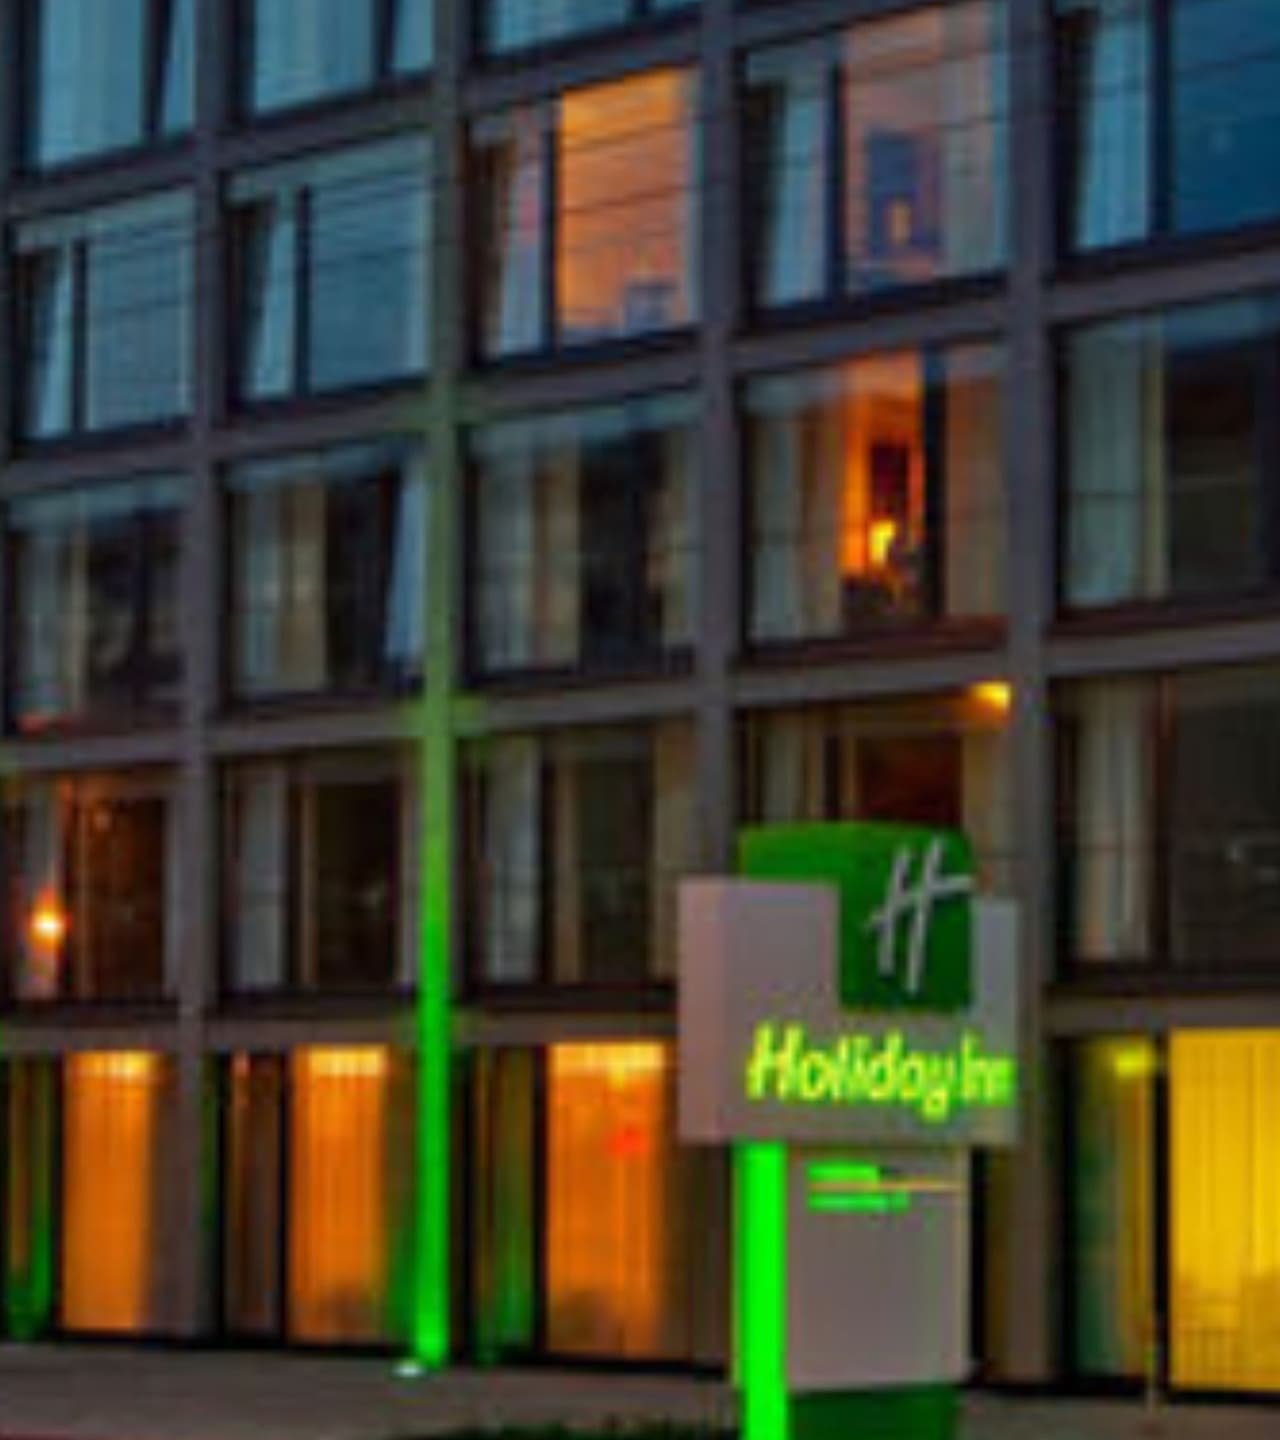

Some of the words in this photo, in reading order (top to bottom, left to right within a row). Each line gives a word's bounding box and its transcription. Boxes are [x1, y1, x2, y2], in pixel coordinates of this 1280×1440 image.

[865, 837, 974, 995] H
[746, 1021, 956, 1123] Holiday
[958, 1028, 1016, 1106] Inn
